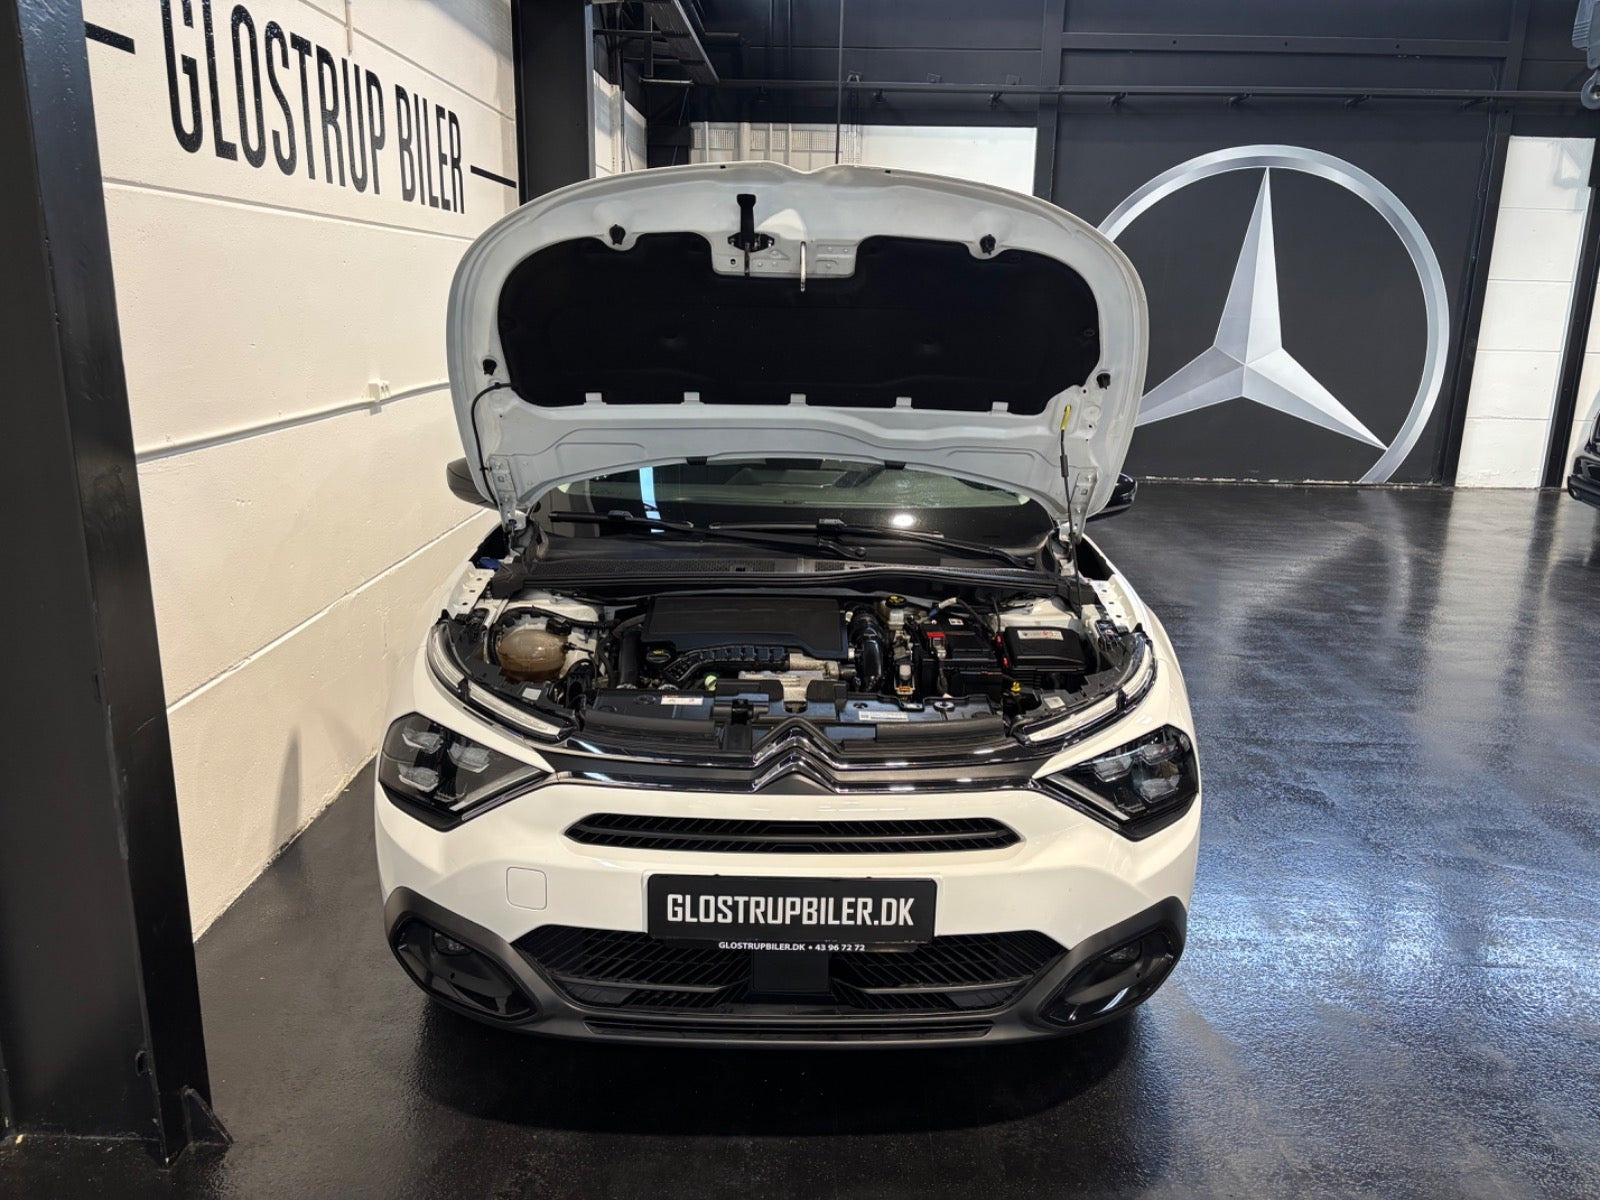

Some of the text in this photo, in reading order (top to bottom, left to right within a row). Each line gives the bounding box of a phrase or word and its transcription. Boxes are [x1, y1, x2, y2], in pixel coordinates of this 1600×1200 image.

[161, 0, 465, 215] GLOSTRUP BILER
[666, 893, 915, 927] GLOSTRUPBILER.DK
[718, 941, 805, 951] GLOSTRUPBILER.DK
[815, 943, 826, 951] 43
[854, 944, 866, 952] 72
